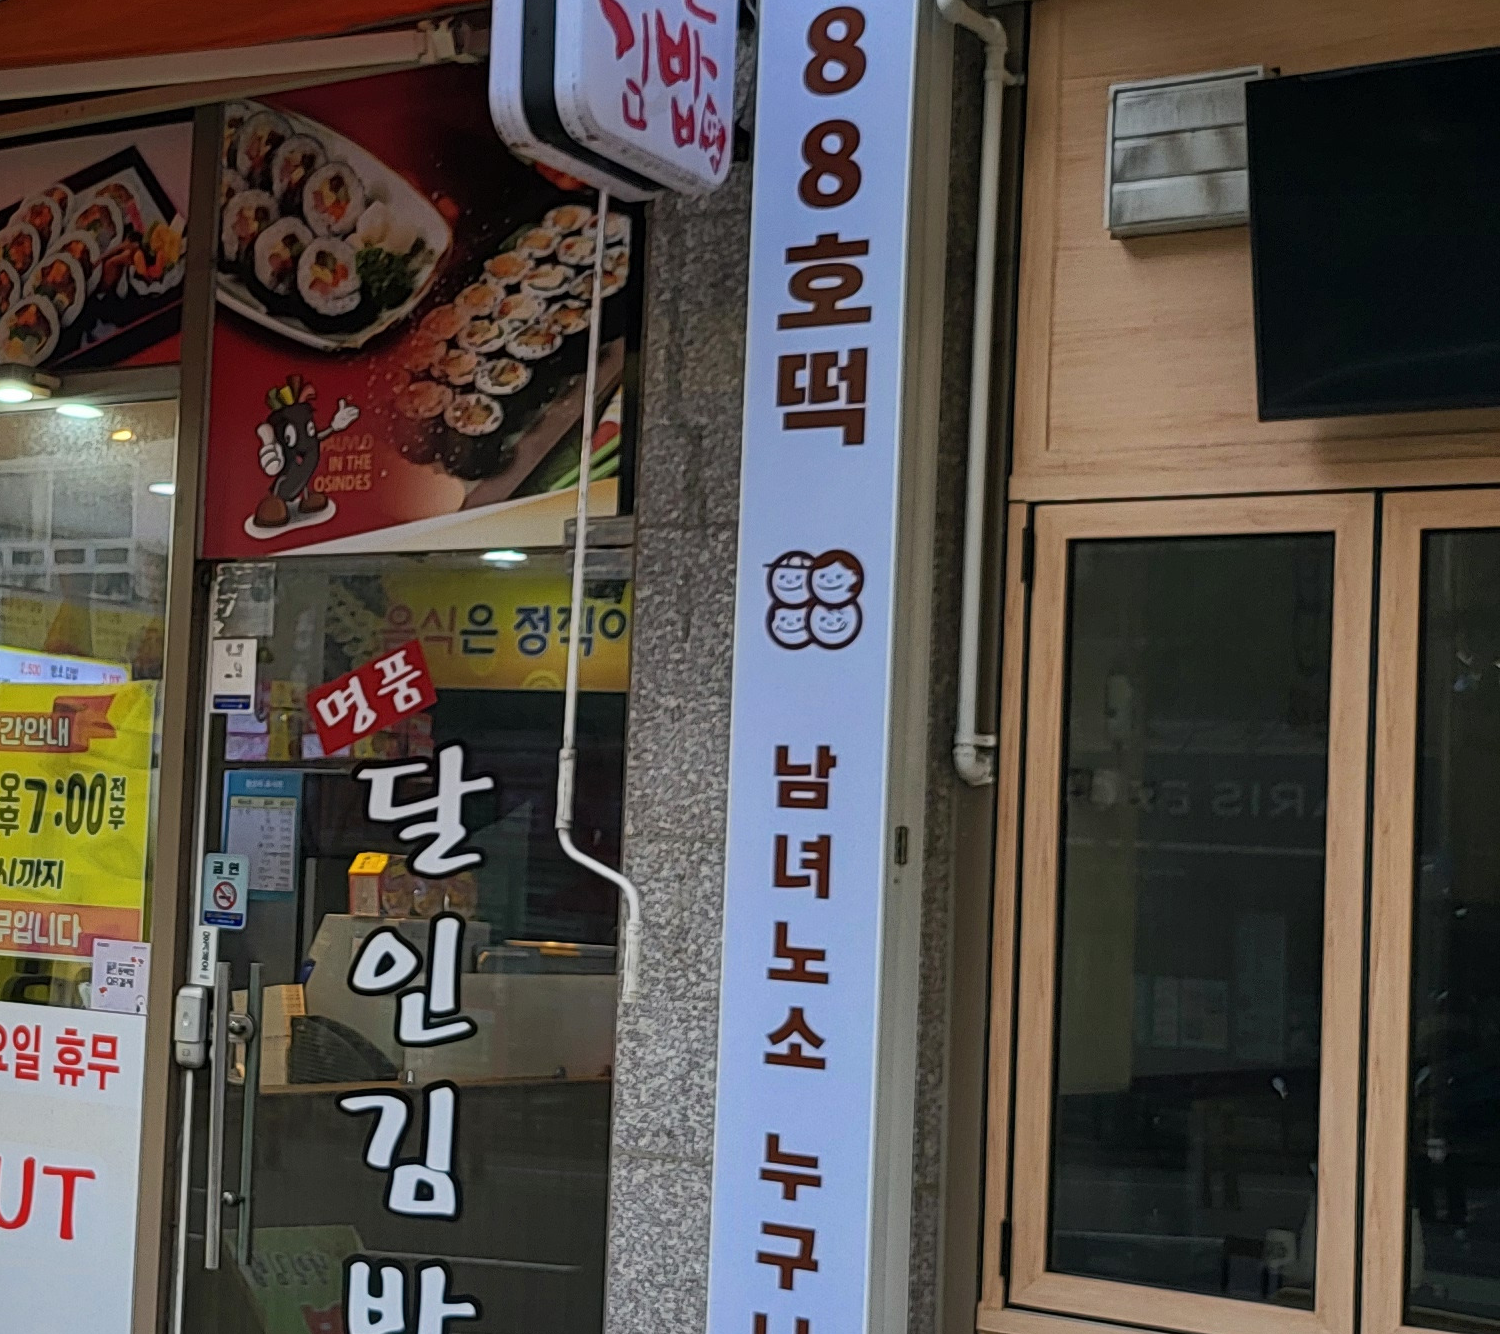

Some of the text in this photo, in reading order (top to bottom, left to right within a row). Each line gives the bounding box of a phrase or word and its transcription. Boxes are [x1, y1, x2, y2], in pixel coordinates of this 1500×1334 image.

[775, 4, 873, 448] 88호떡
[315, 651, 425, 737] 명품
[24, 772, 107, 836] 7:00
[762, 743, 838, 1072] 남녀노소
[52, 1025, 123, 1092] 휴무
